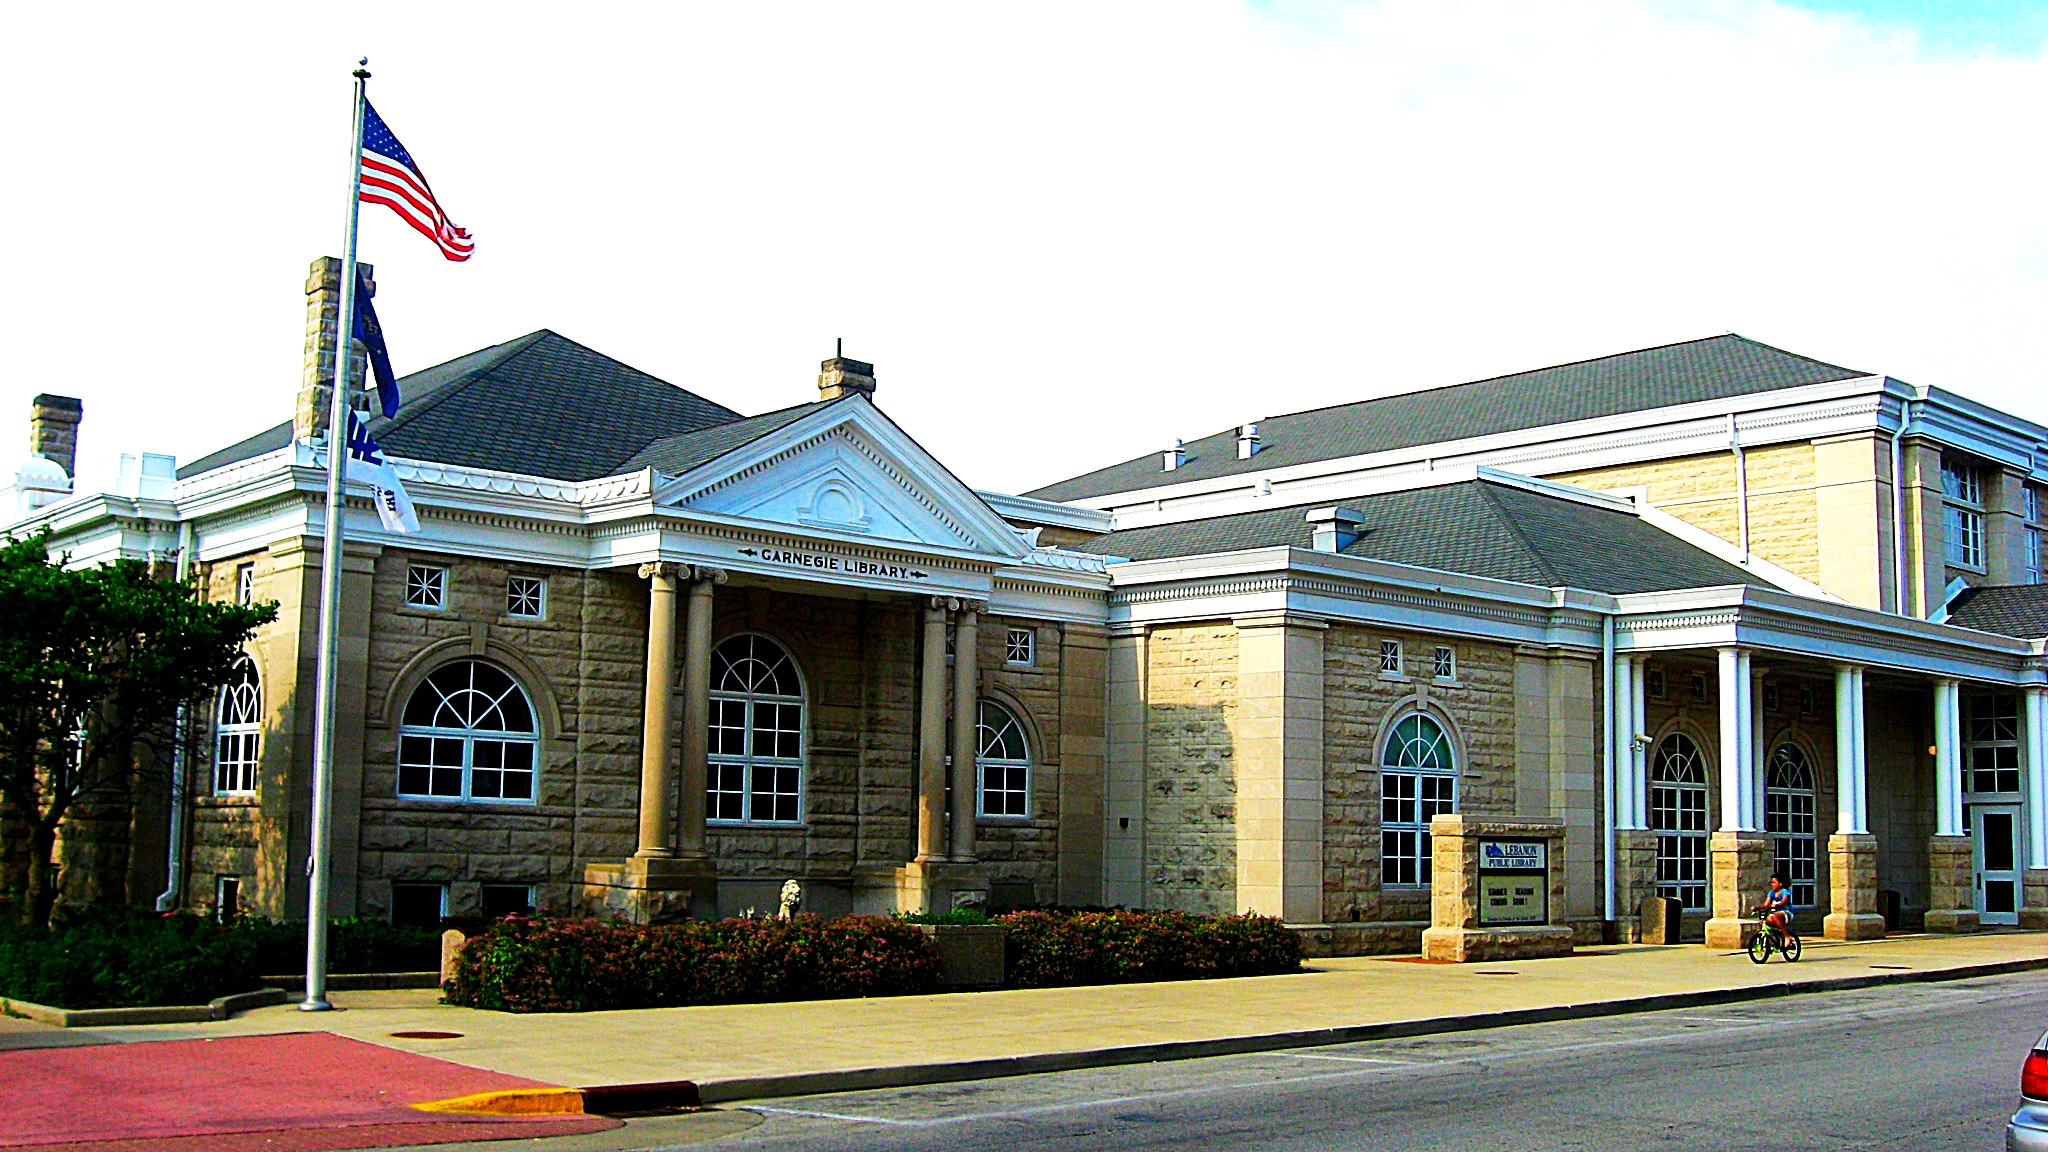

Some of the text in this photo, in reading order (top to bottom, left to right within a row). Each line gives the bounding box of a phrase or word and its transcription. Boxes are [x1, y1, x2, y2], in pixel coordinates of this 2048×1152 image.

[761, 548, 839, 570] CARNEGIE
[1505, 844, 1537, 856] LEBANON
[1489, 859, 1537, 867] PUBLIC LIBRARY
